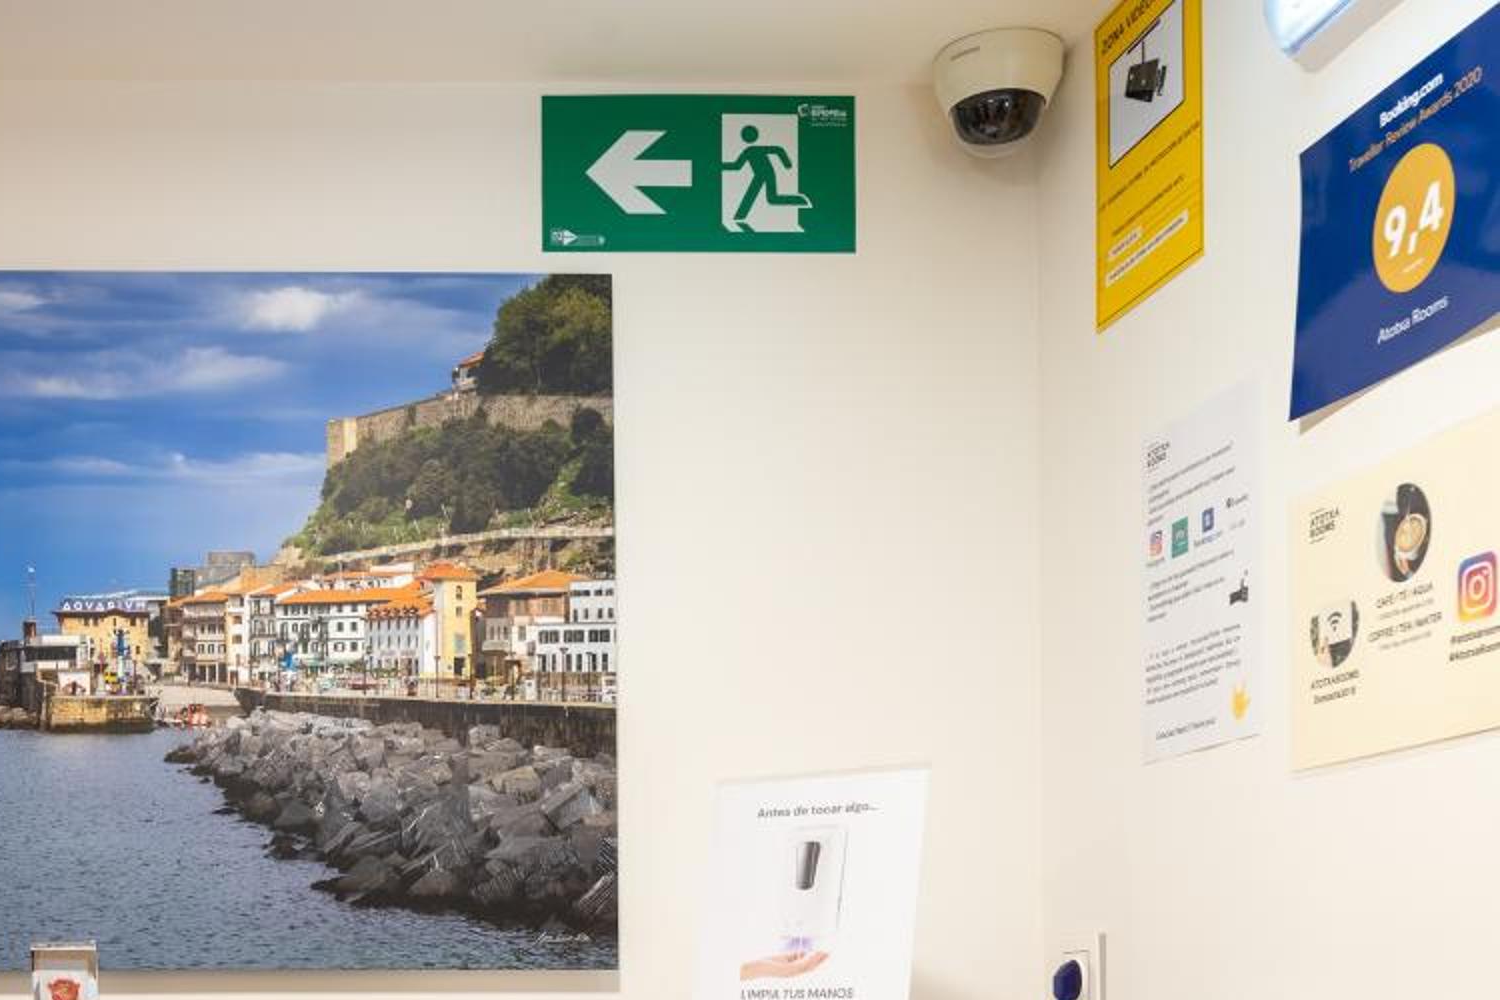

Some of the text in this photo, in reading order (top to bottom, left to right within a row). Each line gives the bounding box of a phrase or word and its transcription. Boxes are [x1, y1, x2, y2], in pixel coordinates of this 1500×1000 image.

[1379, 71, 1444, 129] Booking.com
[1385, 116, 1419, 148] Review
[1452, 65, 1484, 99] 2020
[1383, 181, 1444, 258] 9,4
[1411, 295, 1449, 327] Rooms
[1309, 507, 1340, 528] ATOTXA
[1309, 519, 1336, 538] ROOMS
[756, 808, 791, 818] Antes
[792, 804, 808, 817] de
[810, 804, 842, 816] tocar
[782, 988, 805, 1000] TUS
[806, 987, 854, 1000] MANOS
